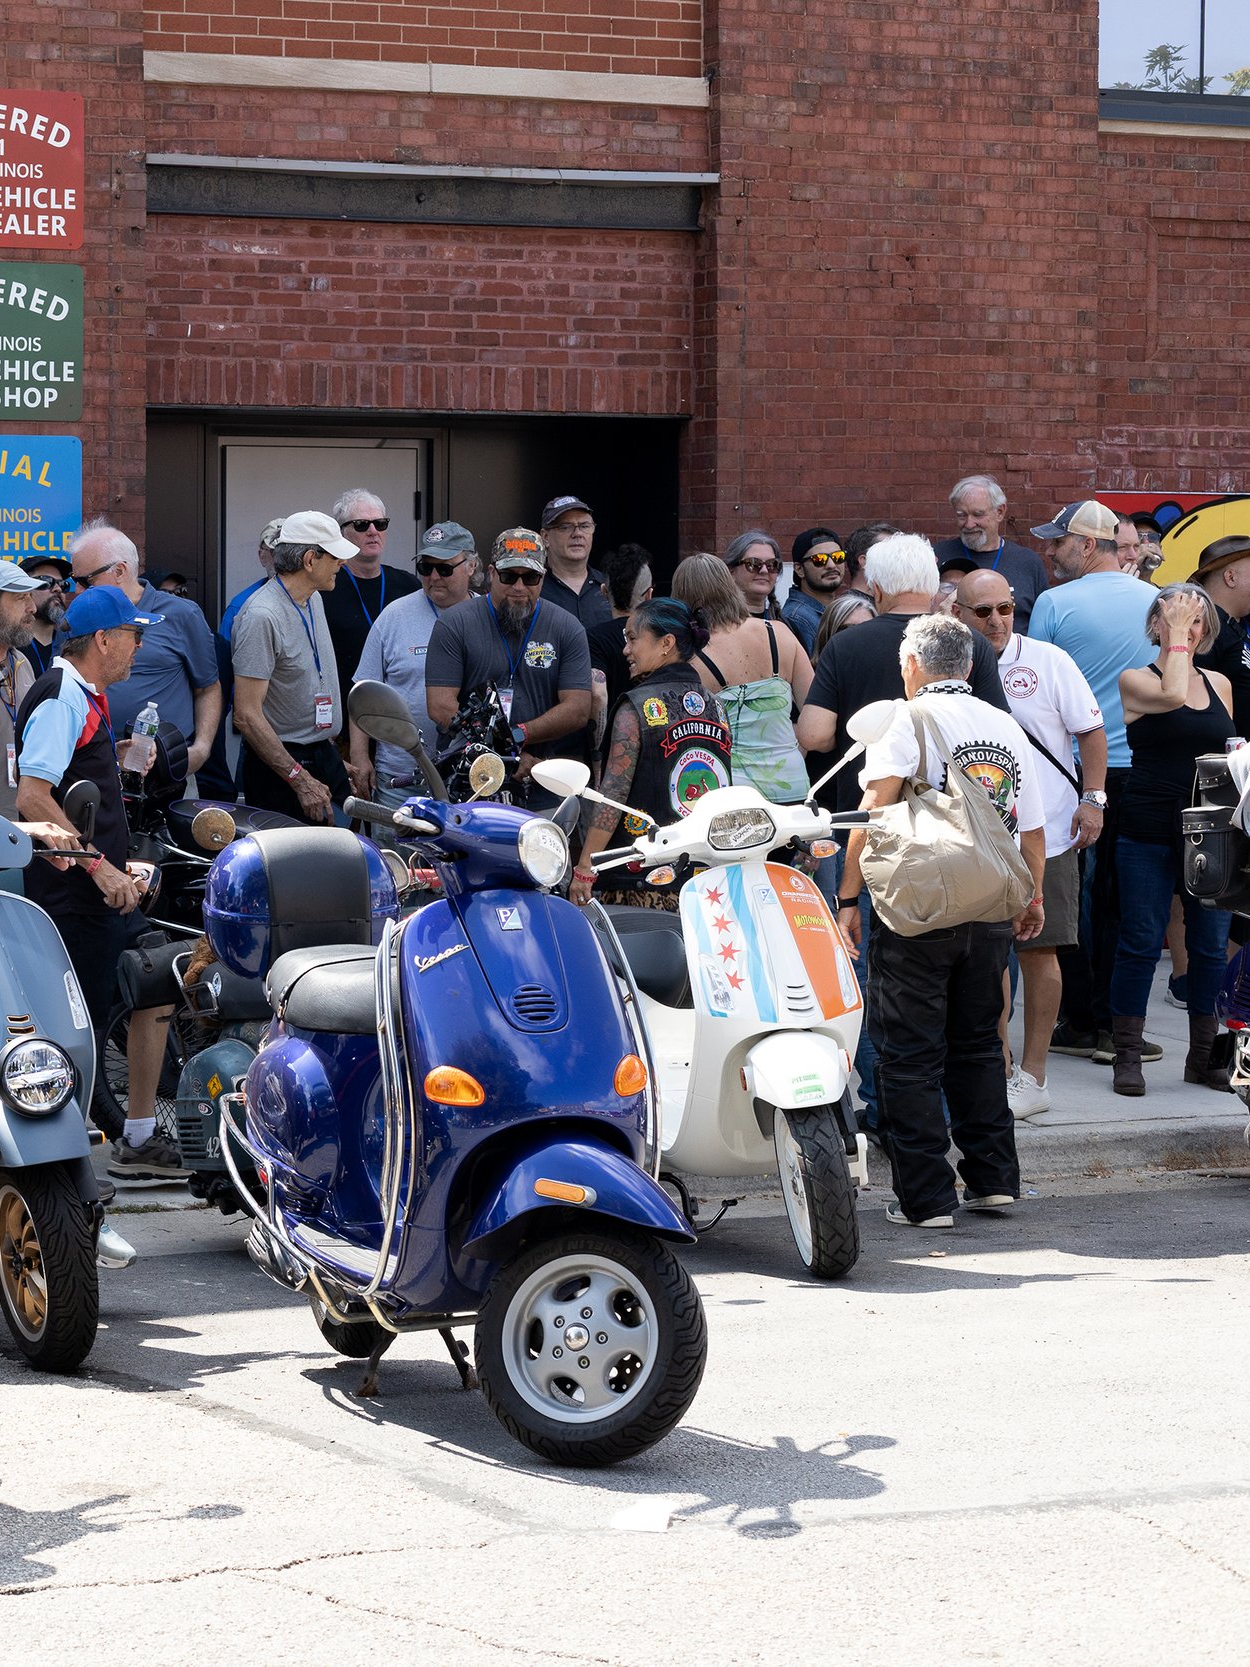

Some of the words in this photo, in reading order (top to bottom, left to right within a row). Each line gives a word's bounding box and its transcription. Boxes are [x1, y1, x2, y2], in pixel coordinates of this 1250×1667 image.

[672, 722, 722, 740] CALIFORNIA
[695, 751, 715, 767] VESPA
[985, 752, 1012, 771] VESPA
[414, 944, 470, 974] Vespa
[206, 1136, 221, 1159] 42
